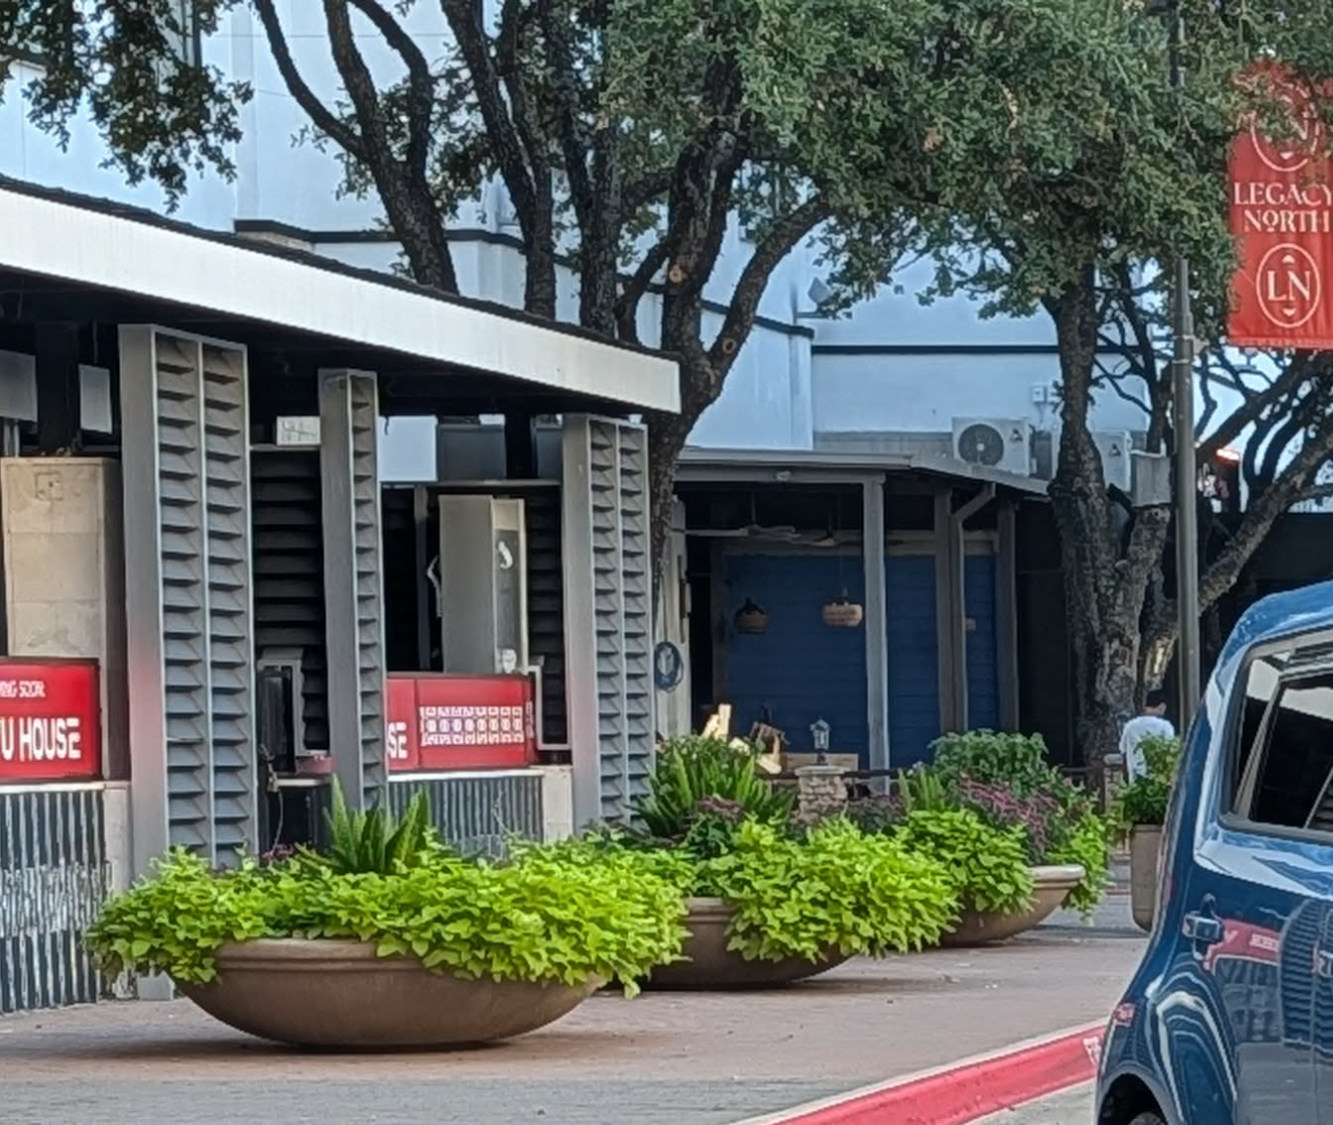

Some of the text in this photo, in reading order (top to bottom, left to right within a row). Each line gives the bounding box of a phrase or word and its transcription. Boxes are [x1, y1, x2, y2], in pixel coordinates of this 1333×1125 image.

[1244, 209, 1330, 233] NORTH
[1267, 270, 1311, 301] LN
[19, 716, 82, 762] HOUSE
